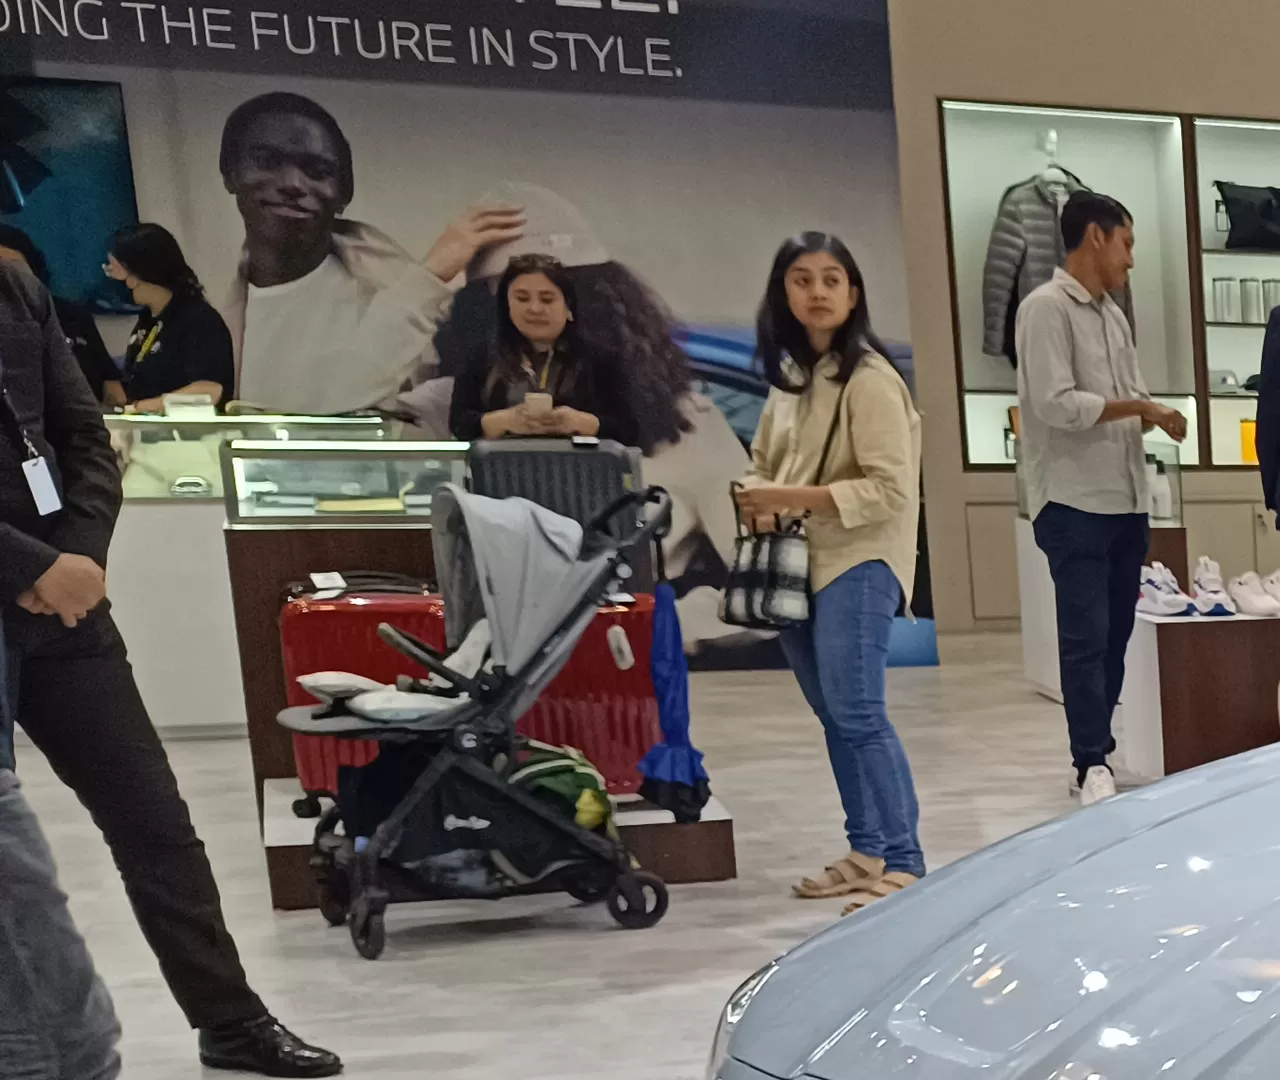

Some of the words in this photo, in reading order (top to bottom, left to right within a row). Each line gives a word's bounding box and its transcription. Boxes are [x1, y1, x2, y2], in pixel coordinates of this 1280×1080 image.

[121, 2, 236, 50] THE
[251, 11, 456, 64] FUTURE
[469, 26, 516, 67] IN
[529, 29, 683, 78] STYLE.
